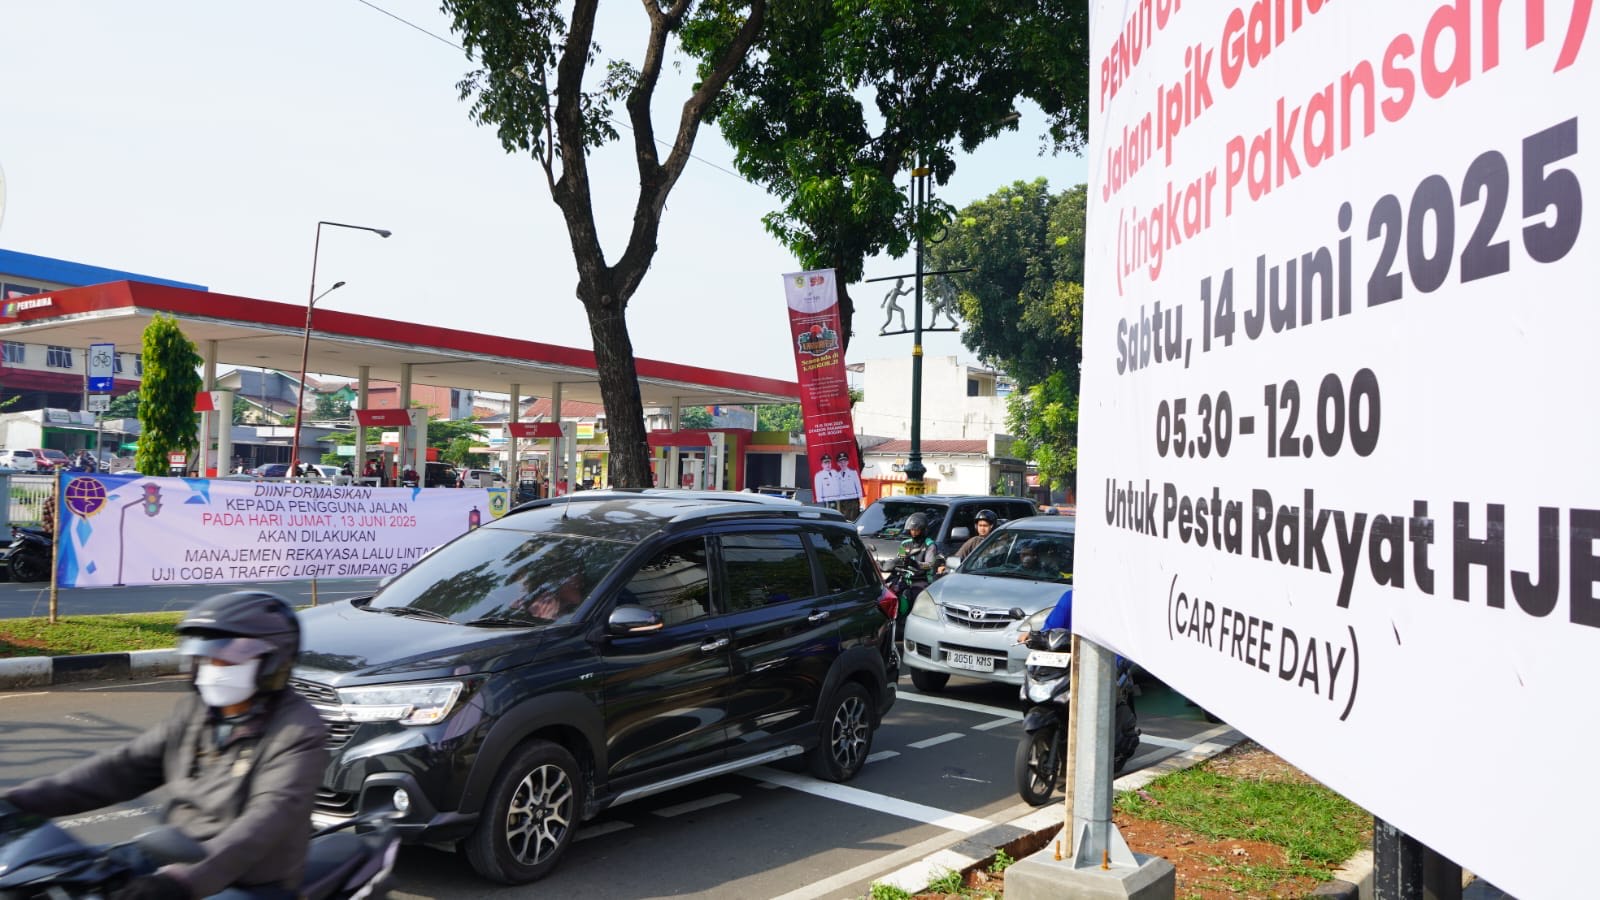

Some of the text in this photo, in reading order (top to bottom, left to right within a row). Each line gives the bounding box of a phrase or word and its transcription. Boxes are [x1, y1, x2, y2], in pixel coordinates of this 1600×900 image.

[1103, 110, 1152, 204] Jalan
[1156, 41, 1215, 168] Ipik
[1115, 155, 1218, 297] (Lingkar
[1116, 116, 1583, 376] Sabtu, 14 Juni 2025
[1155, 367, 1383, 461] 05.30 - 12.00
[254, 484, 373, 500] DIINFORMASIKAN
[226, 498, 408, 514] KEPADA PENGGUNA JALAN
[202, 512, 417, 528] PADA HARI JUMAT, 13 JUNI 2025
[257, 530, 376, 543] AKAN DILAKUKAN
[1105, 477, 1159, 539] Untuk
[1162, 481, 1244, 556] Pesta
[1250, 487, 1435, 610] Rakyat
[184, 547, 435, 563] MANAJEMEN REKAYASA LALU LINTA
[151, 567, 175, 581] UJI
[180, 567, 224, 581] COBA
[229, 565, 290, 579] TRAFFIC
[293, 564, 336, 577] LIGHT
[338, 563, 401, 576] SIMPANG
[1167, 573, 1360, 722] (CAR FREE DAY)
[976, 655, 992, 667] KMS
